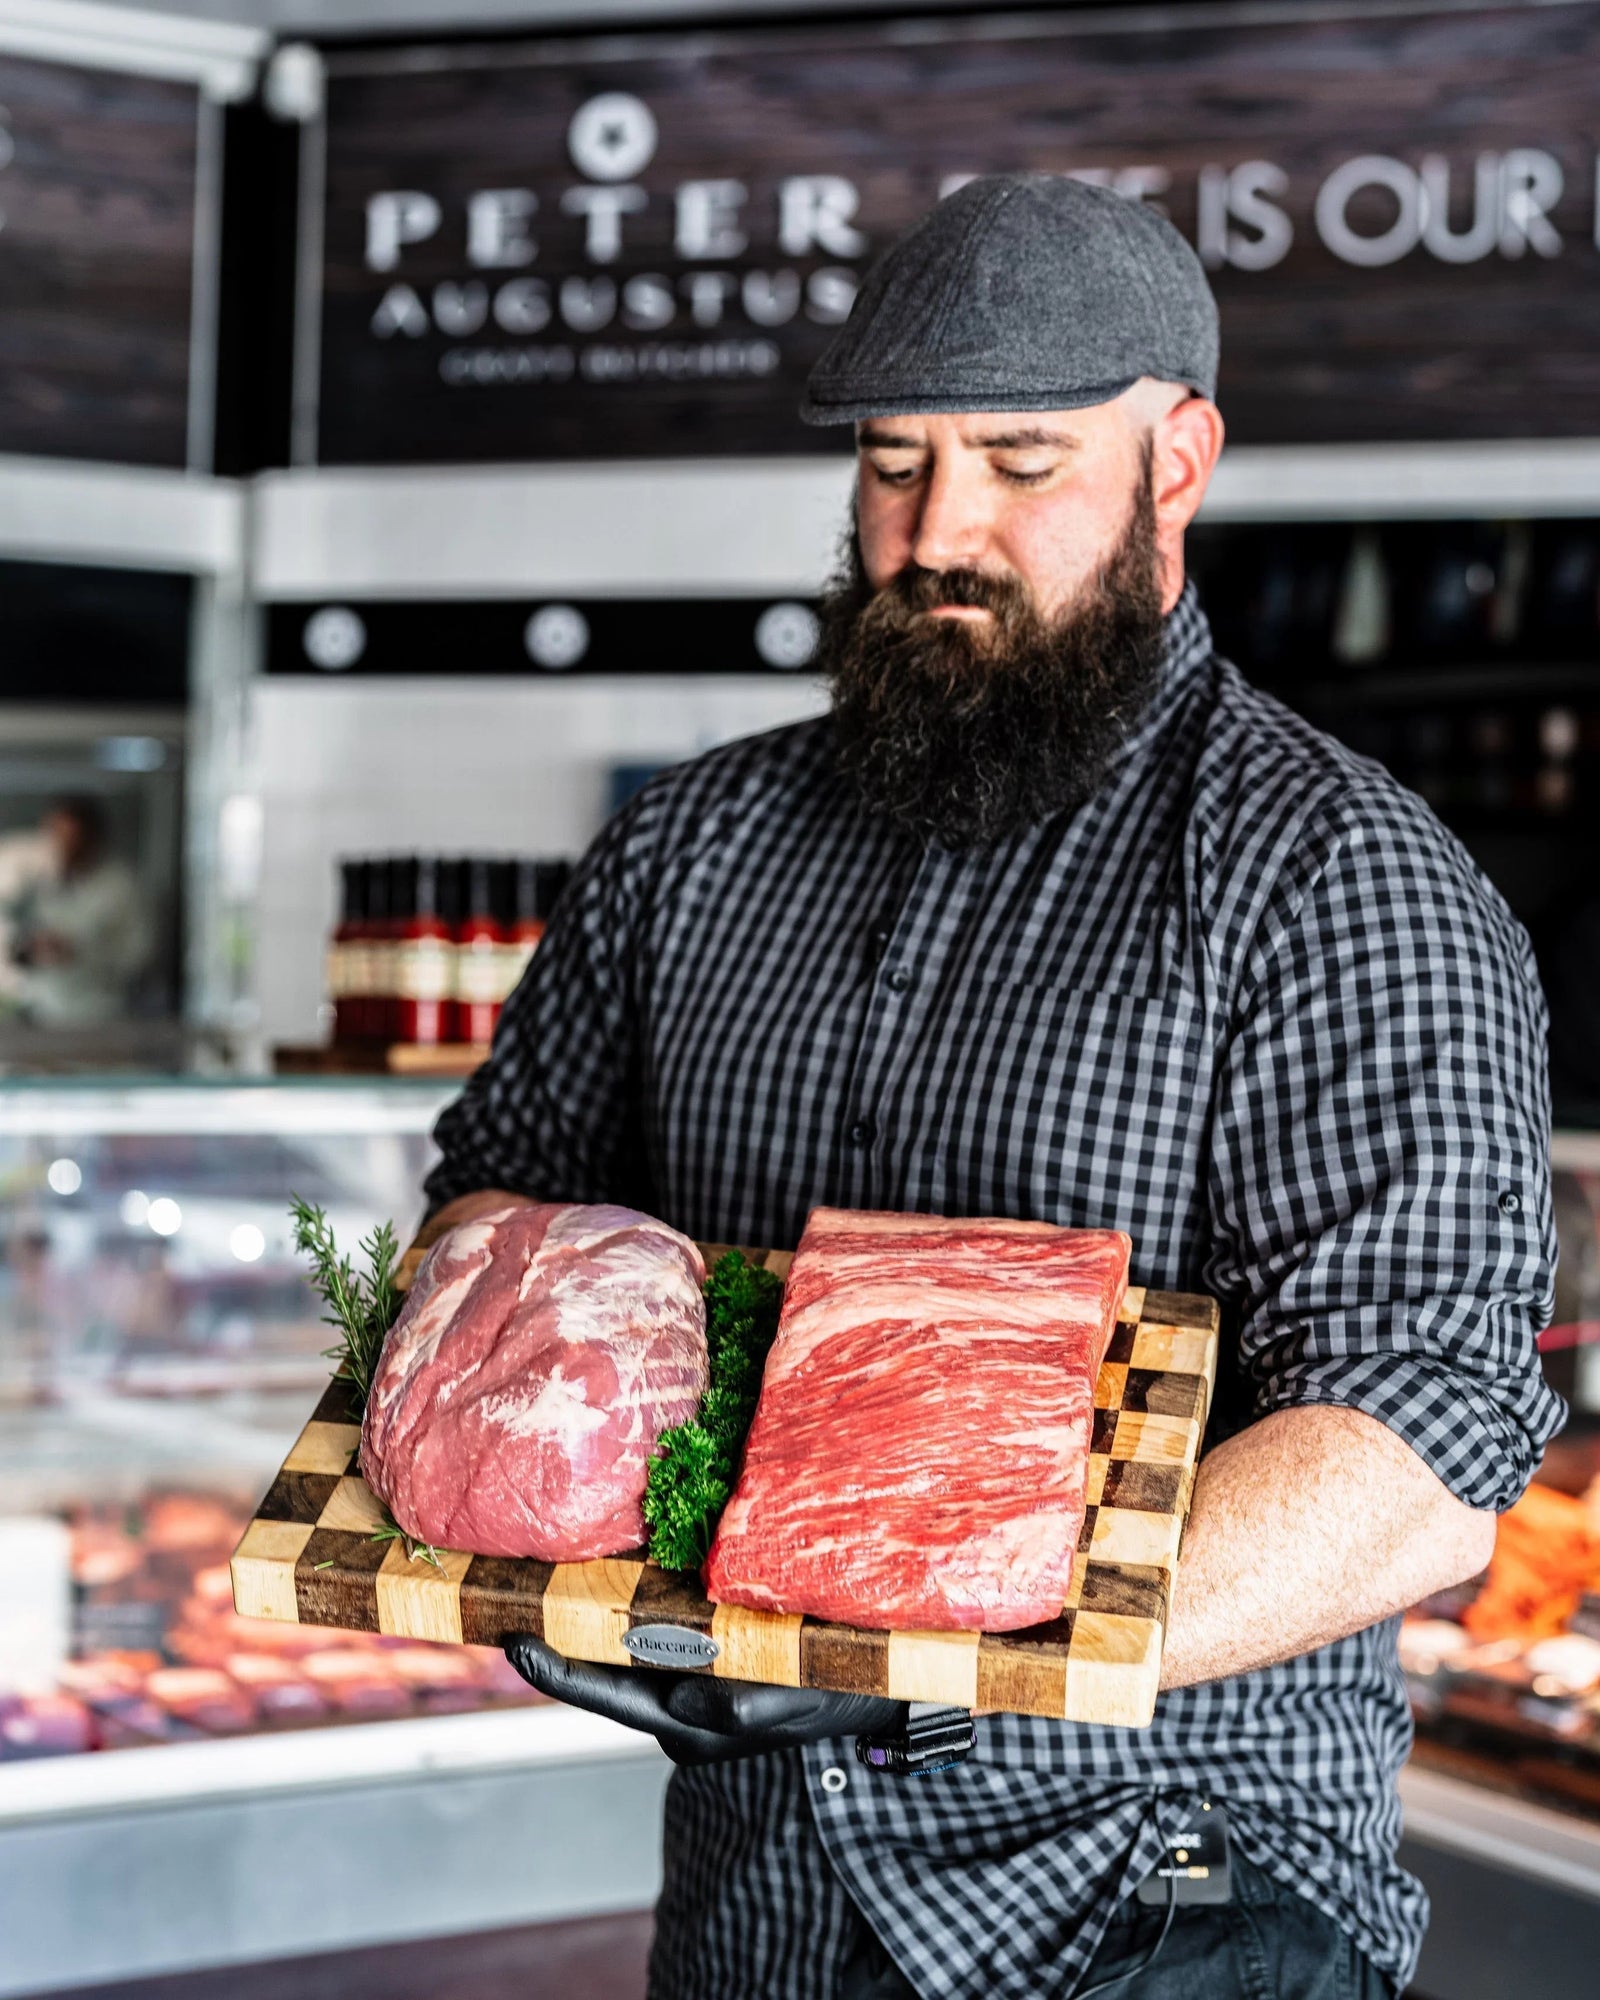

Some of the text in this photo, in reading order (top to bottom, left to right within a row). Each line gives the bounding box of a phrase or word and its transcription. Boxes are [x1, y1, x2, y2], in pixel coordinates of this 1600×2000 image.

[367, 175, 866, 271] PETER
[1198, 160, 1293, 271] IS
[1315, 148, 1564, 267] OUR
[370, 270, 857, 337] AUGUSTUS
[639, 1637, 702, 1655] Baccarat
